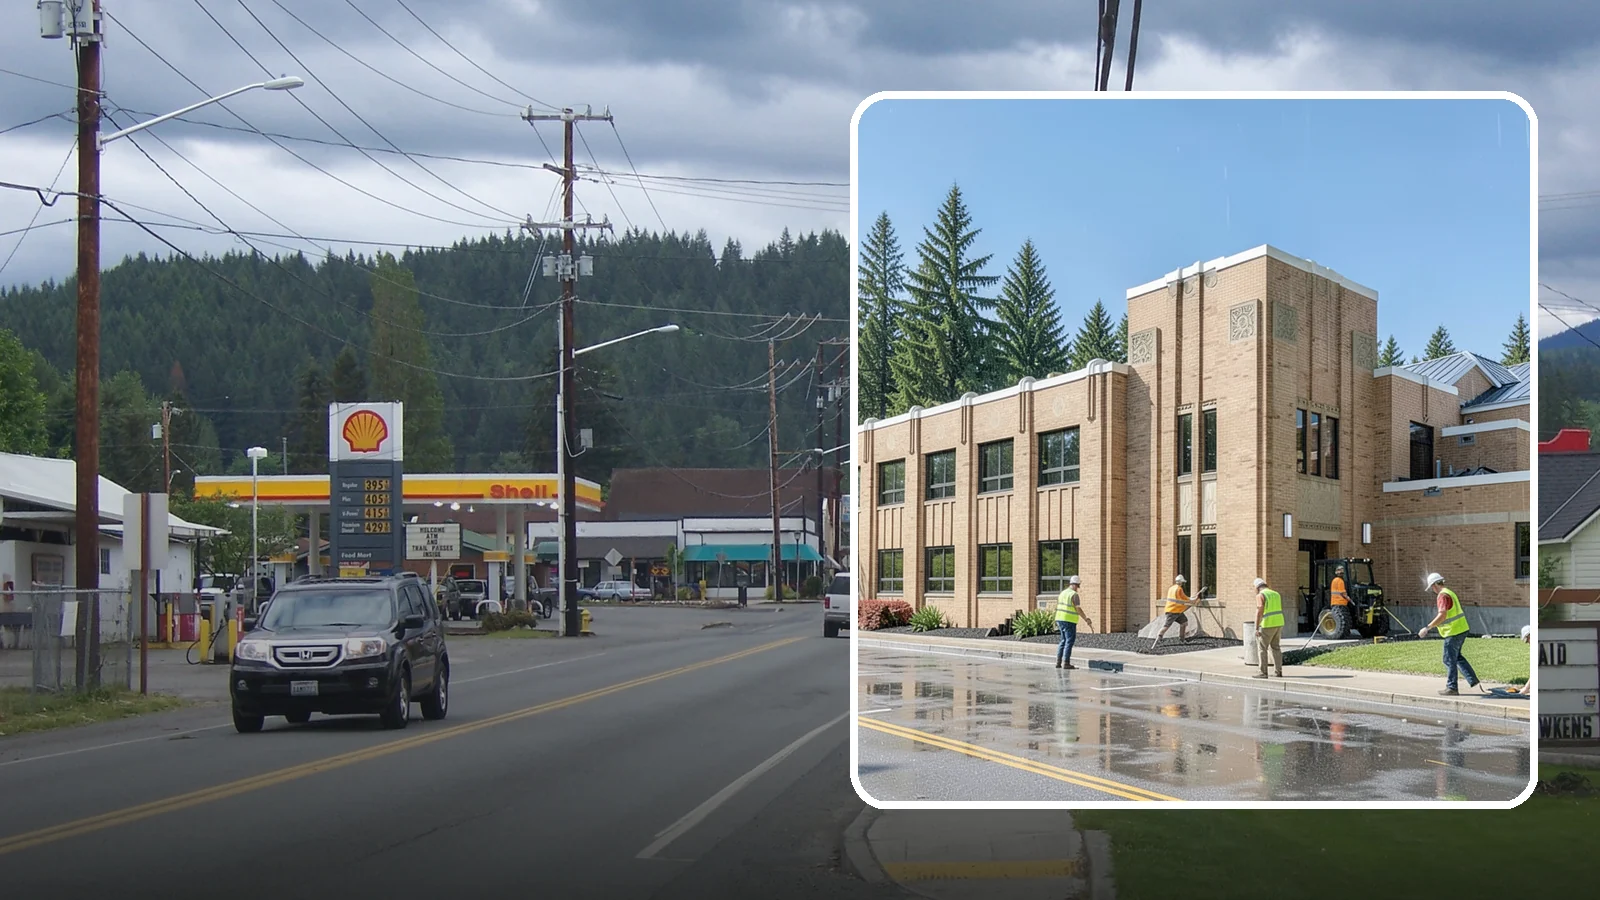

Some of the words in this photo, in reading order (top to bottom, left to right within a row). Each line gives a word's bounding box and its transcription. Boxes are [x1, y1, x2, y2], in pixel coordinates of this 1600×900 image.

[366, 480, 383, 490] 395
[490, 484, 547, 499] Shell
[366, 494, 383, 504] 405
[366, 508, 383, 518] 415
[366, 522, 383, 532] 429
